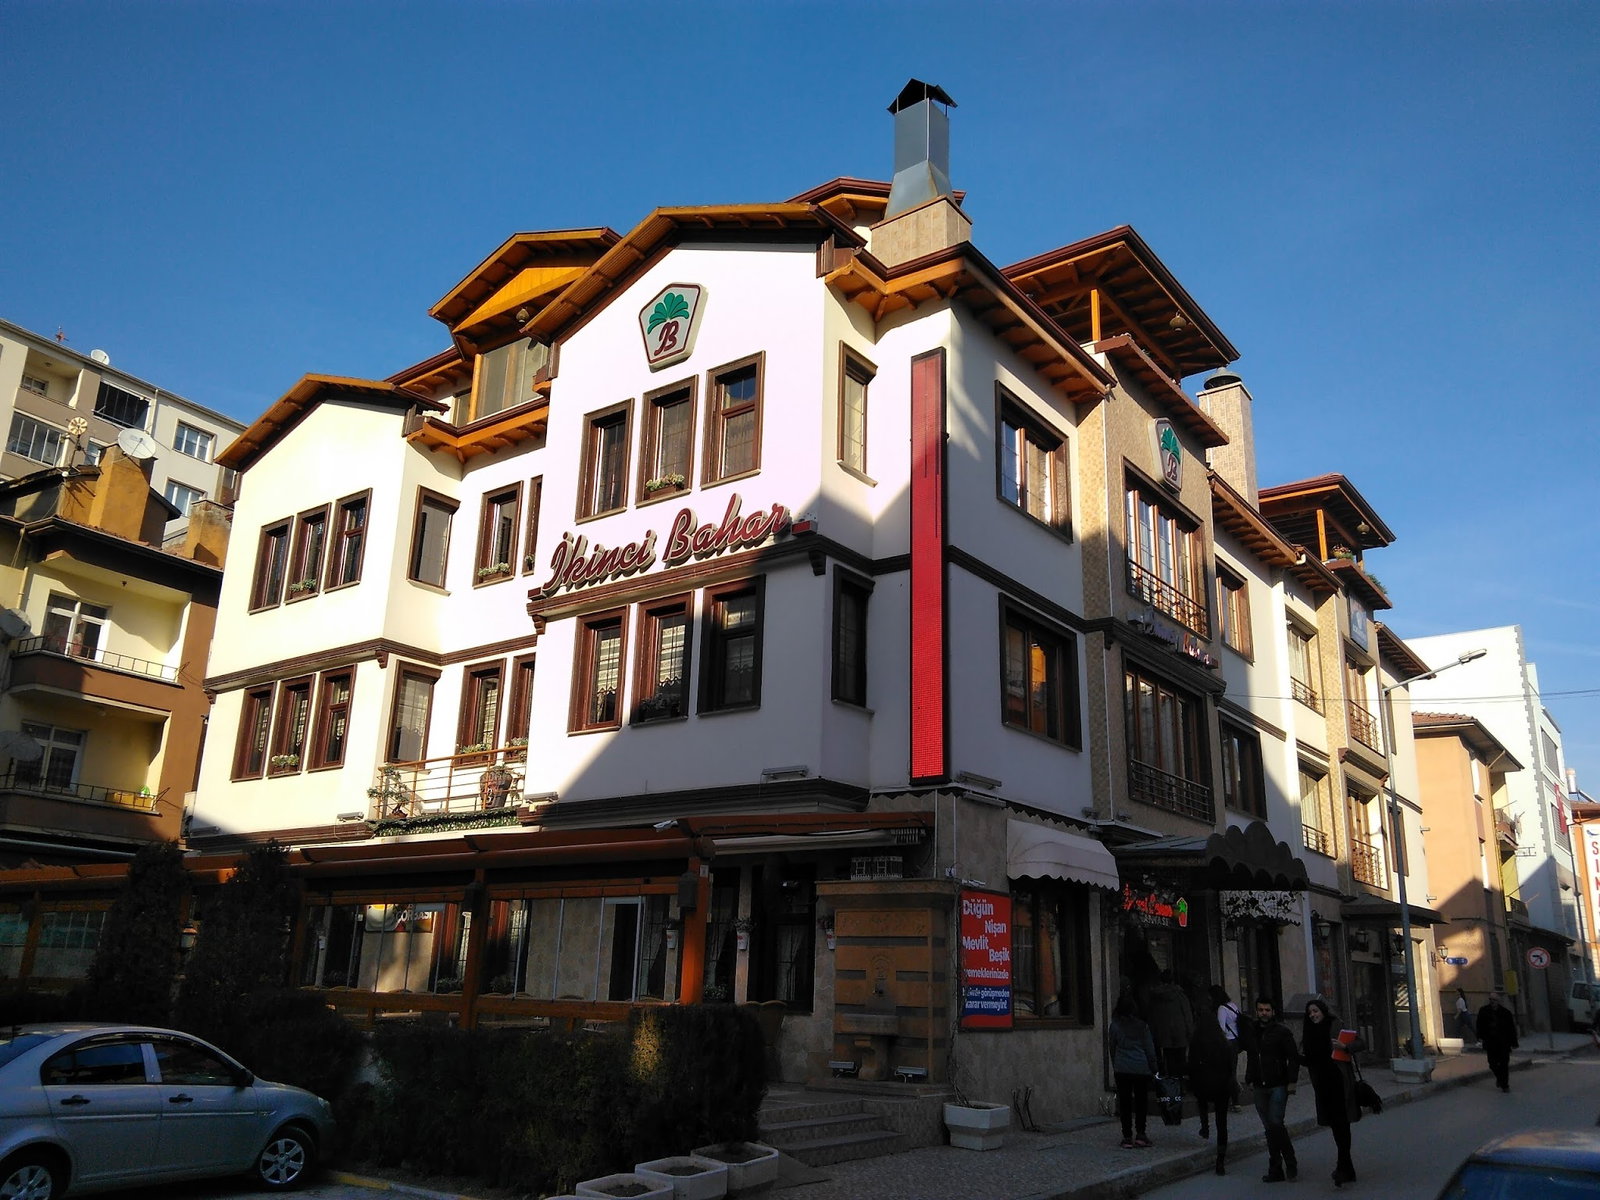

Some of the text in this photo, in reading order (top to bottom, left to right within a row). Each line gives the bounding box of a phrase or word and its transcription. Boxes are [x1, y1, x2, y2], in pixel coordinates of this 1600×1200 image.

[541, 493, 790, 592] İkinci Bahar
[963, 899, 993, 918] Düğün
[985, 920, 1007, 937] Nişan
[963, 935, 989, 950] Mevlit
[989, 947, 1011, 965] Beşik
